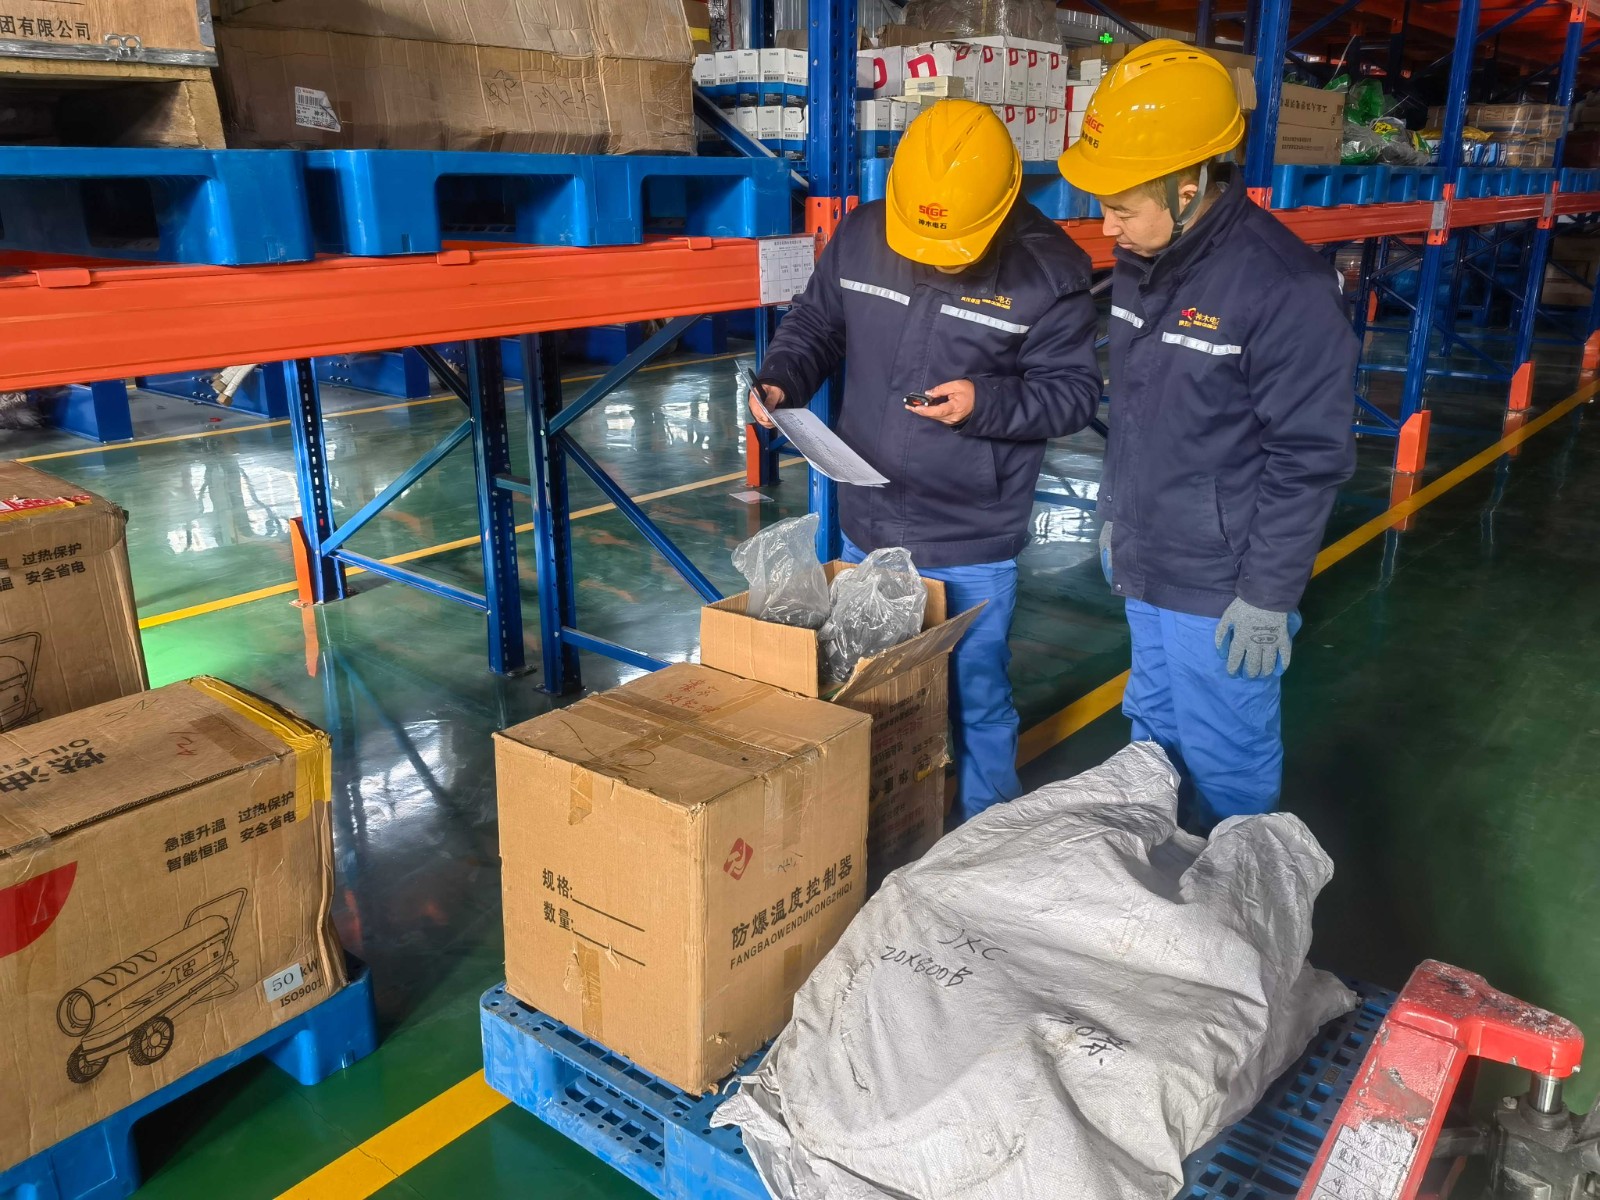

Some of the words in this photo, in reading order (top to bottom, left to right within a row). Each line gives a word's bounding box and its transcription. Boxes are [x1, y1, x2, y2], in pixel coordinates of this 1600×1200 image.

[0, 14, 91, 40] 团有限公司
[918, 218, 948, 230] 神木电石
[22, 542, 82, 566] 过热保护
[25, 561, 86, 585] 安全省电
[0, 738, 90, 774] OIL-FI
[0, 747, 107, 793] 燃油
[164, 817, 227, 853] 急速升温
[238, 791, 295, 823] 过热保护
[166, 837, 229, 873] 智能恒温
[240, 810, 297, 843] 安全省电
[731, 854, 853, 950] 防爆温度控制器
[730, 881, 853, 970] FANGBAOWENDUKONGZHIQI
[272, 972, 294, 992] 50
[300, 958, 318, 977] kW
[280, 978, 324, 1007] ISO9001
